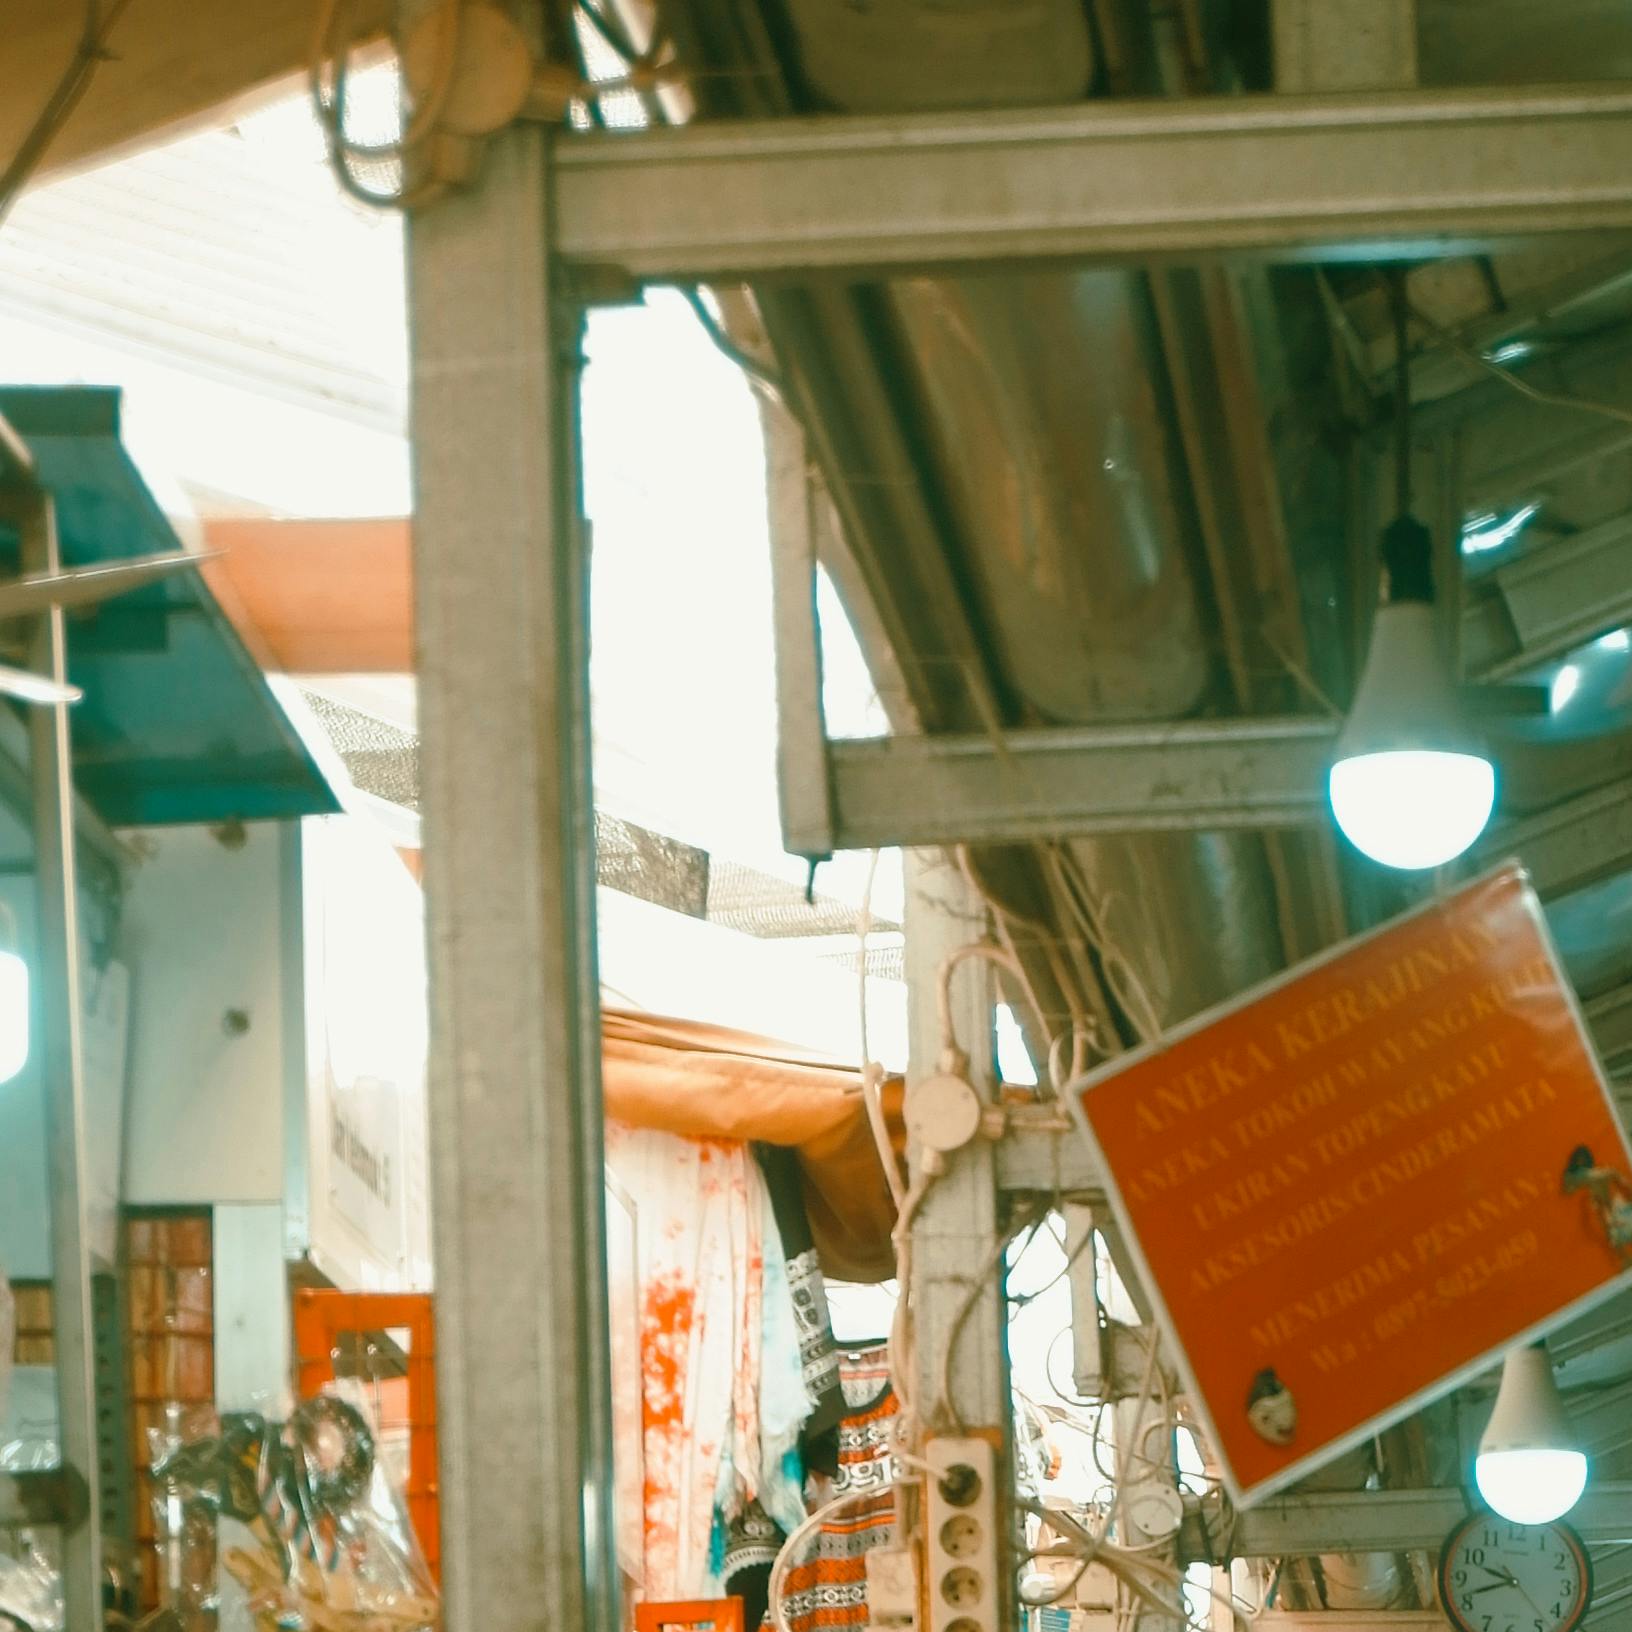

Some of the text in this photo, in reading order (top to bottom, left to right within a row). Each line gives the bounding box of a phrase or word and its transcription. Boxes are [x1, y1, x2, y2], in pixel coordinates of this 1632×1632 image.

[1128, 1034, 1276, 1138] ANEKA
[1121, 1128, 1230, 1206] ANEKA
[1229, 1071, 1338, 1149] TOKOH
[1338, 1002, 1468, 1090] WAYANG
[1311, 1082, 1431, 1167] TOPENG
[1429, 1038, 1510, 1101] KAYU
[1483, 1530, 1498, 1547] 11
[1538, 1534, 1546, 1550] 1
[1464, 1548, 1484, 1567] 10
[1553, 1554, 1565, 1570] 2
[1455, 1570, 1467, 1587] 9
[1560, 1580, 1571, 1596] 3
[1462, 1595, 1473, 1611] 8
[1550, 1602, 1561, 1619] 4
[1482, 1616, 1492, 1632] 7
